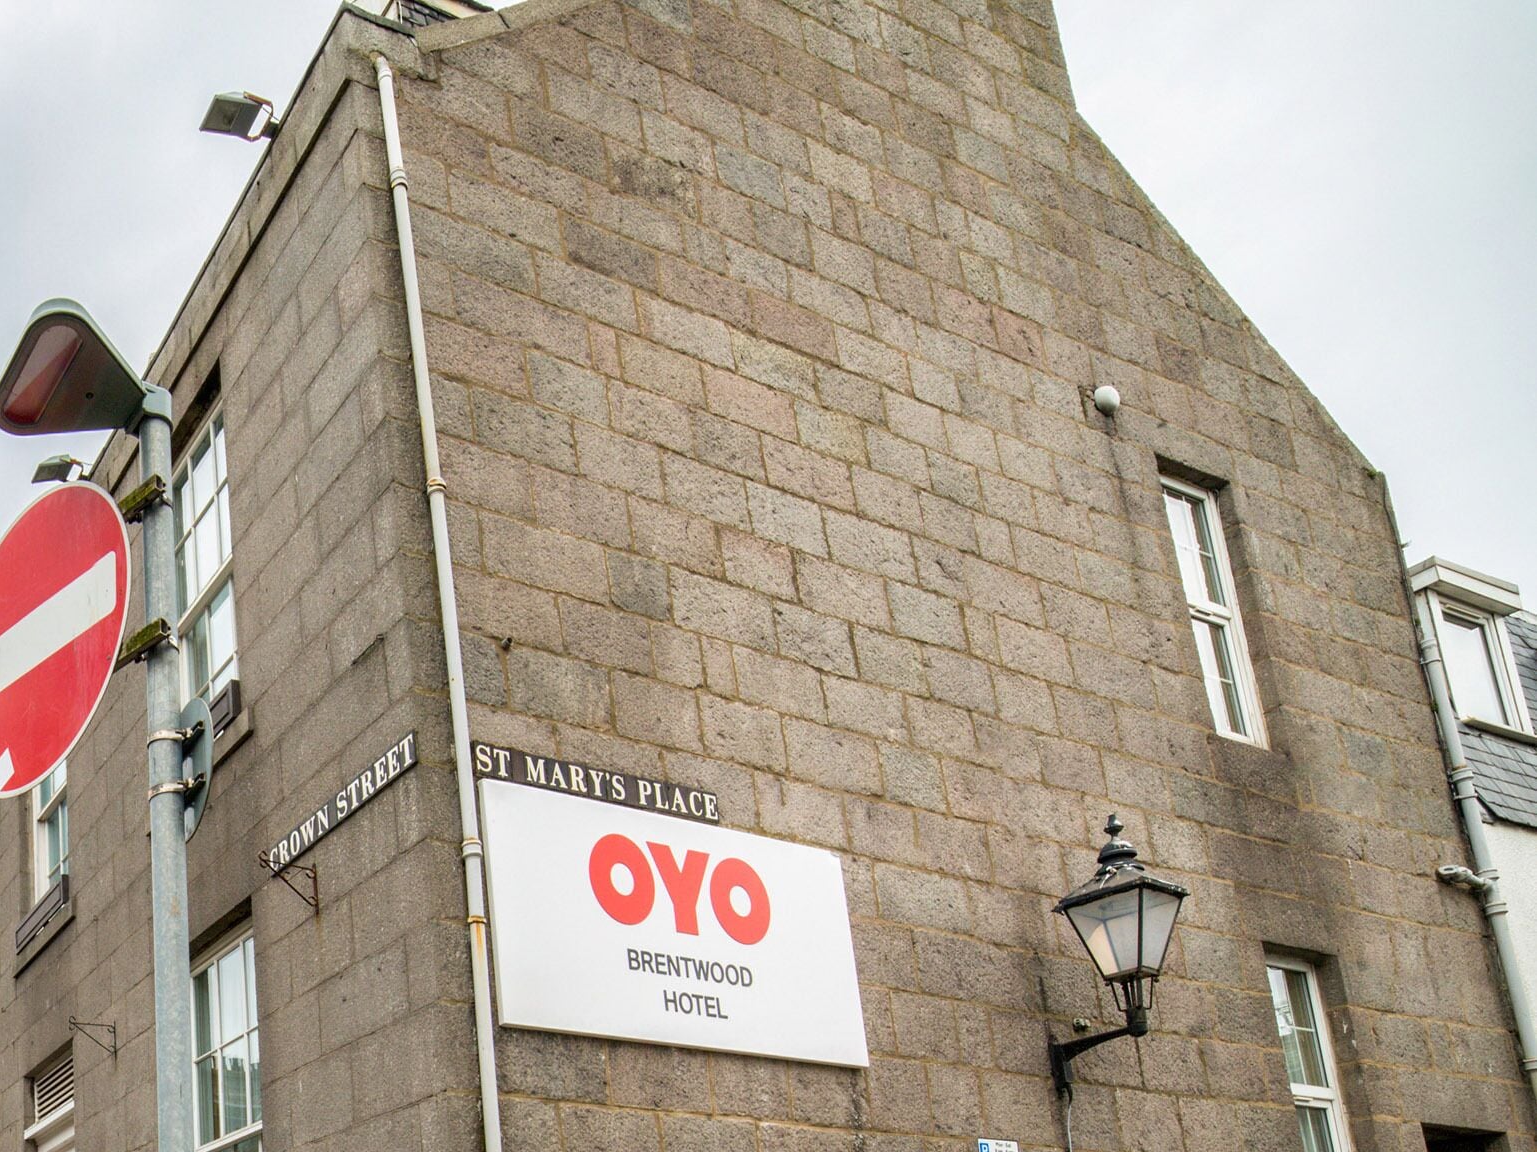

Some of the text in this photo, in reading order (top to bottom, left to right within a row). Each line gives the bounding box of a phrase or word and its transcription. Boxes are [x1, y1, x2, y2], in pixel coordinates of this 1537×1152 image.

[268, 733, 414, 871] CROWN STREET
[475, 744, 719, 821] ST MARY'S PLACE
[588, 833, 771, 946] OYO
[627, 948, 753, 987] BRENTWOOD
[663, 989, 729, 1020] HOTEL
